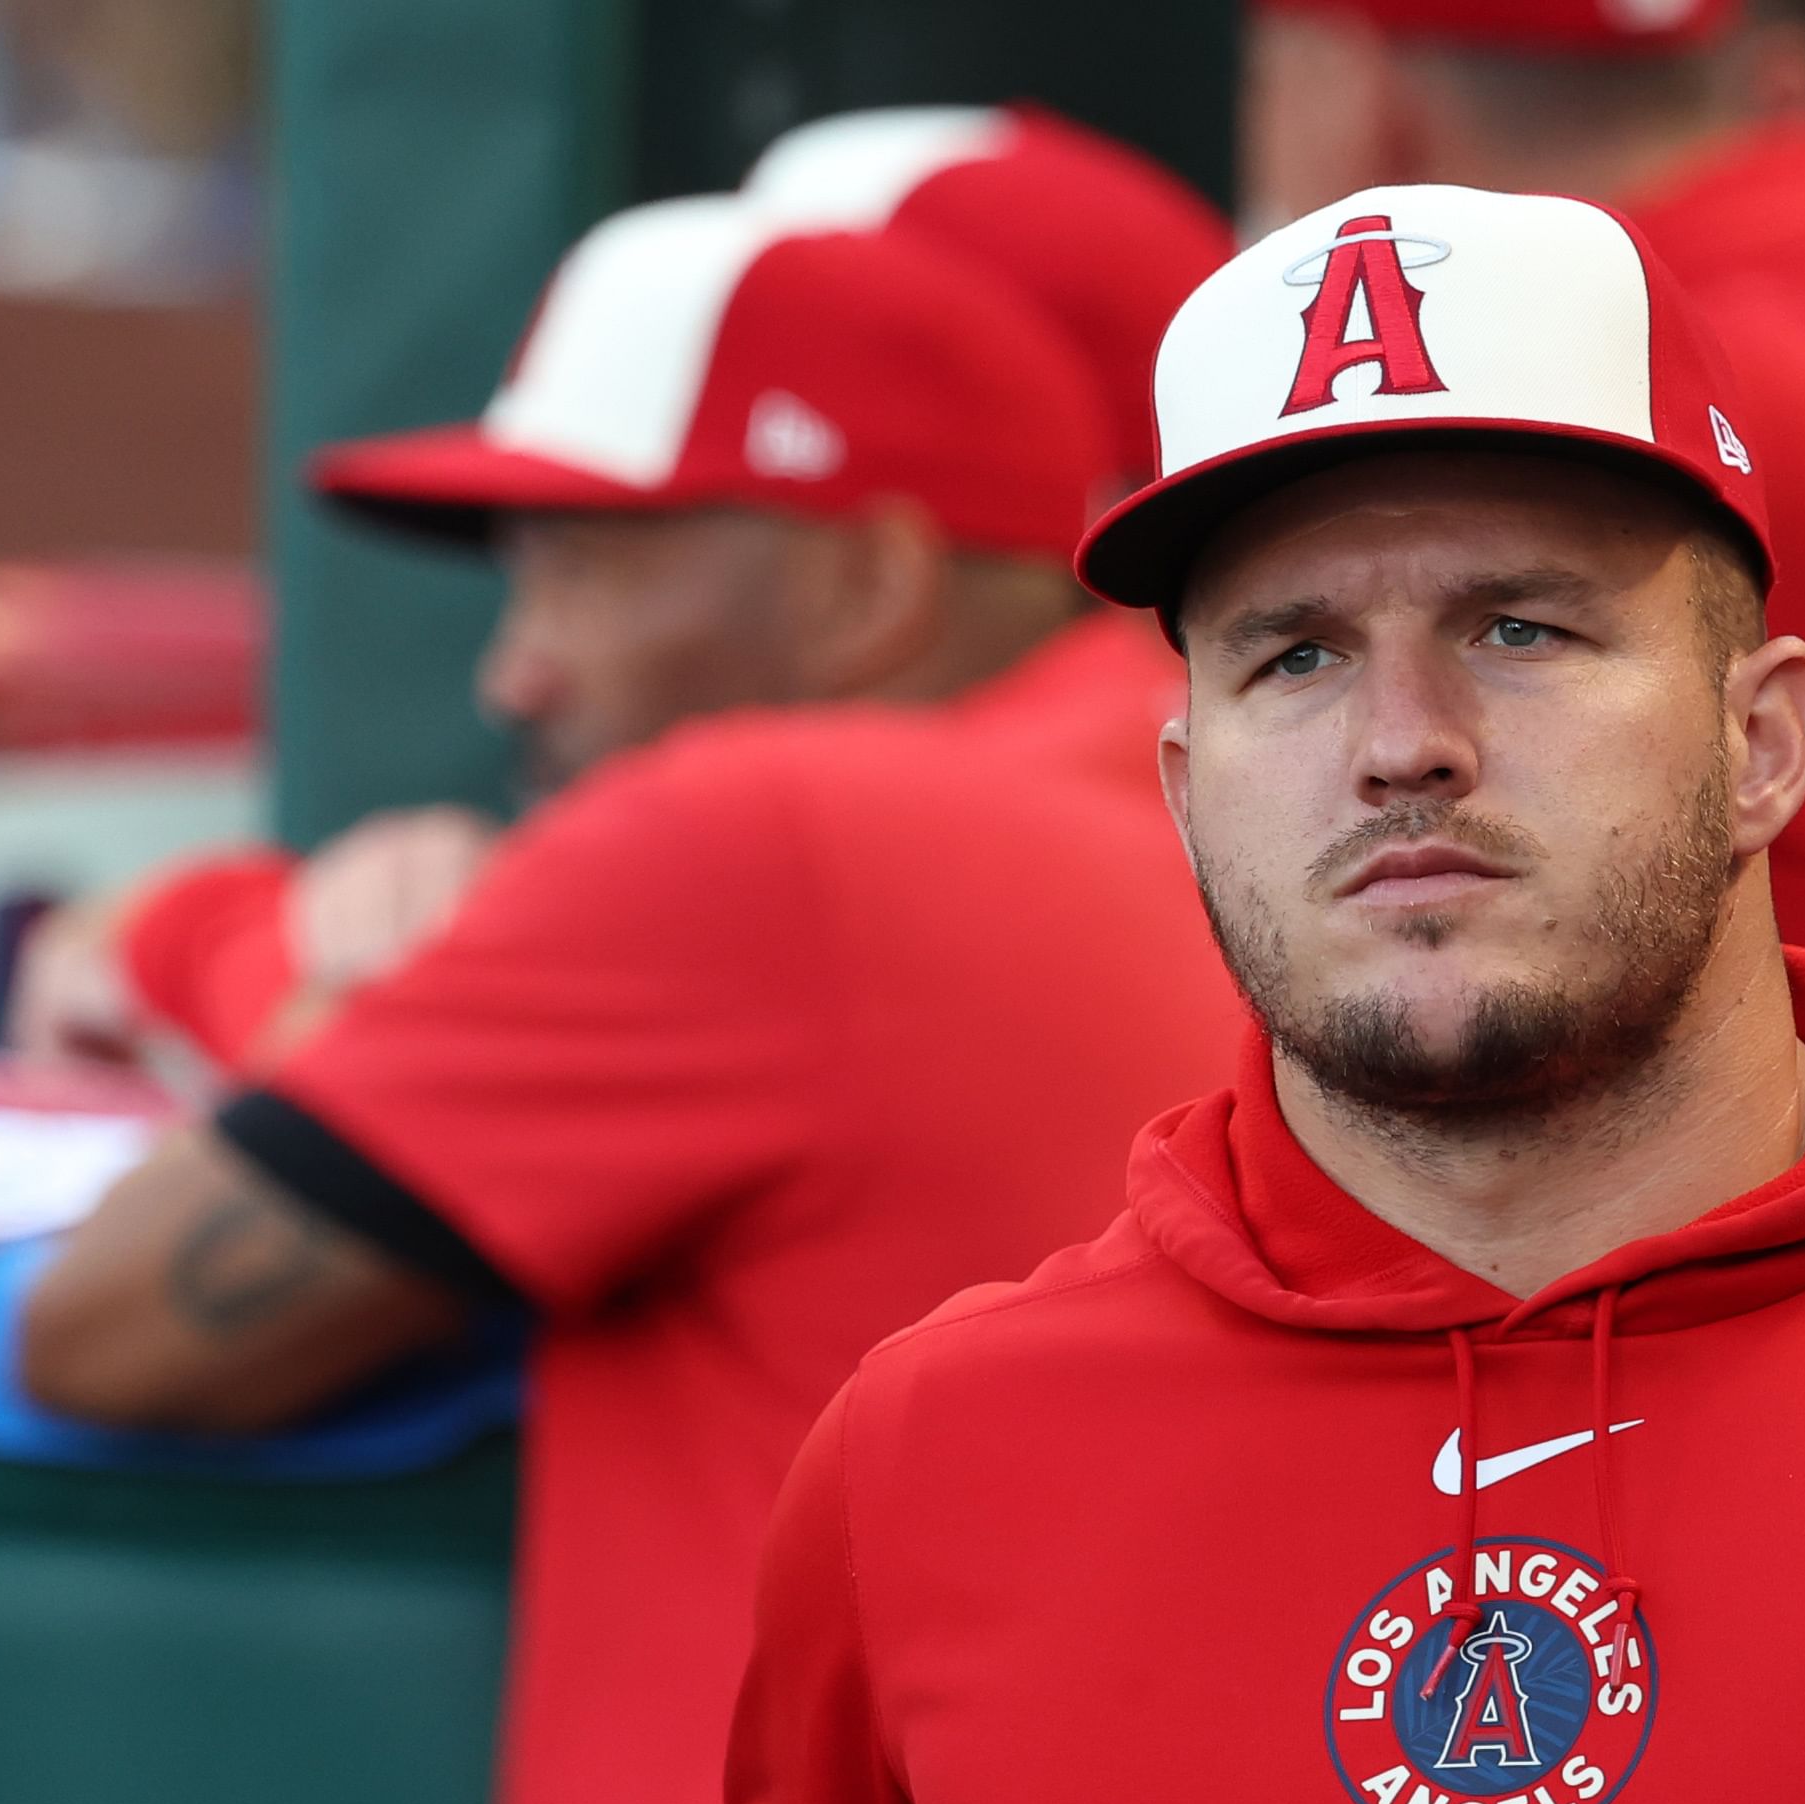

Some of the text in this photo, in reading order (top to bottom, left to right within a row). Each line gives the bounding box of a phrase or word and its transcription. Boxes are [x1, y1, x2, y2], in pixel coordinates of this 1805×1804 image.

[1278, 215, 1450, 419] A
[1339, 1549, 1643, 1721] LOS ANGELES
[1433, 1610, 1543, 1769] A
